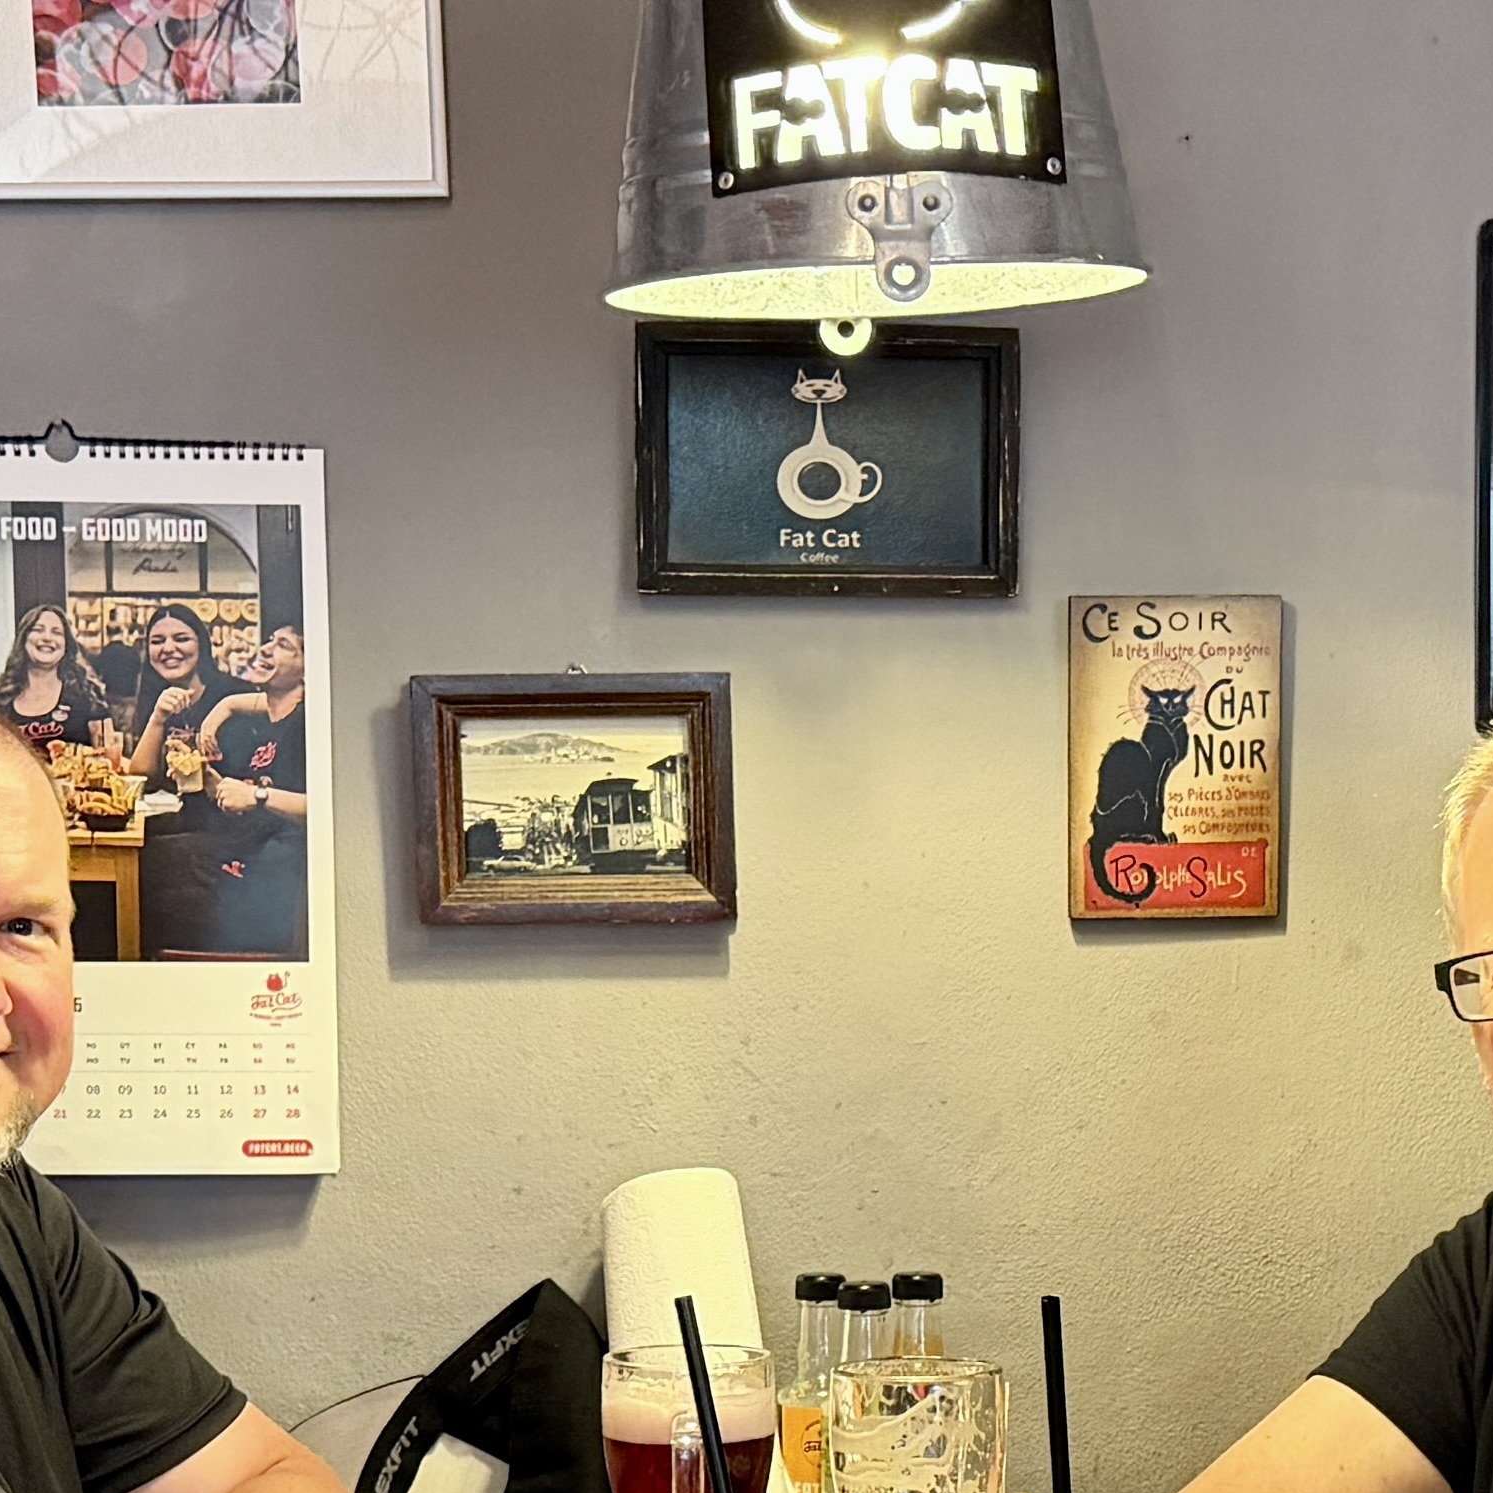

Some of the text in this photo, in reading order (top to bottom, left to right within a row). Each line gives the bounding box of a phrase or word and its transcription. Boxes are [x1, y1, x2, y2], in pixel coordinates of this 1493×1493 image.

[1, 516, 57, 541] FOOD
[81, 518, 140, 542] GOOD
[145, 518, 207, 543] MOOD
[779, 528, 861, 548] Fat Cat
[800, 552, 839, 563] Coffee
[1153, 641, 1194, 662] illustre
[1199, 641, 1271, 662] Compagnie
[1204, 678, 1270, 731] CHAT
[1194, 734, 1267, 778] NOIR
[86, 1084, 299, 1095] 08 09 10 11 12 13 14
[53, 1108, 301, 1119] 21 22 23 24 25 26 27 28
